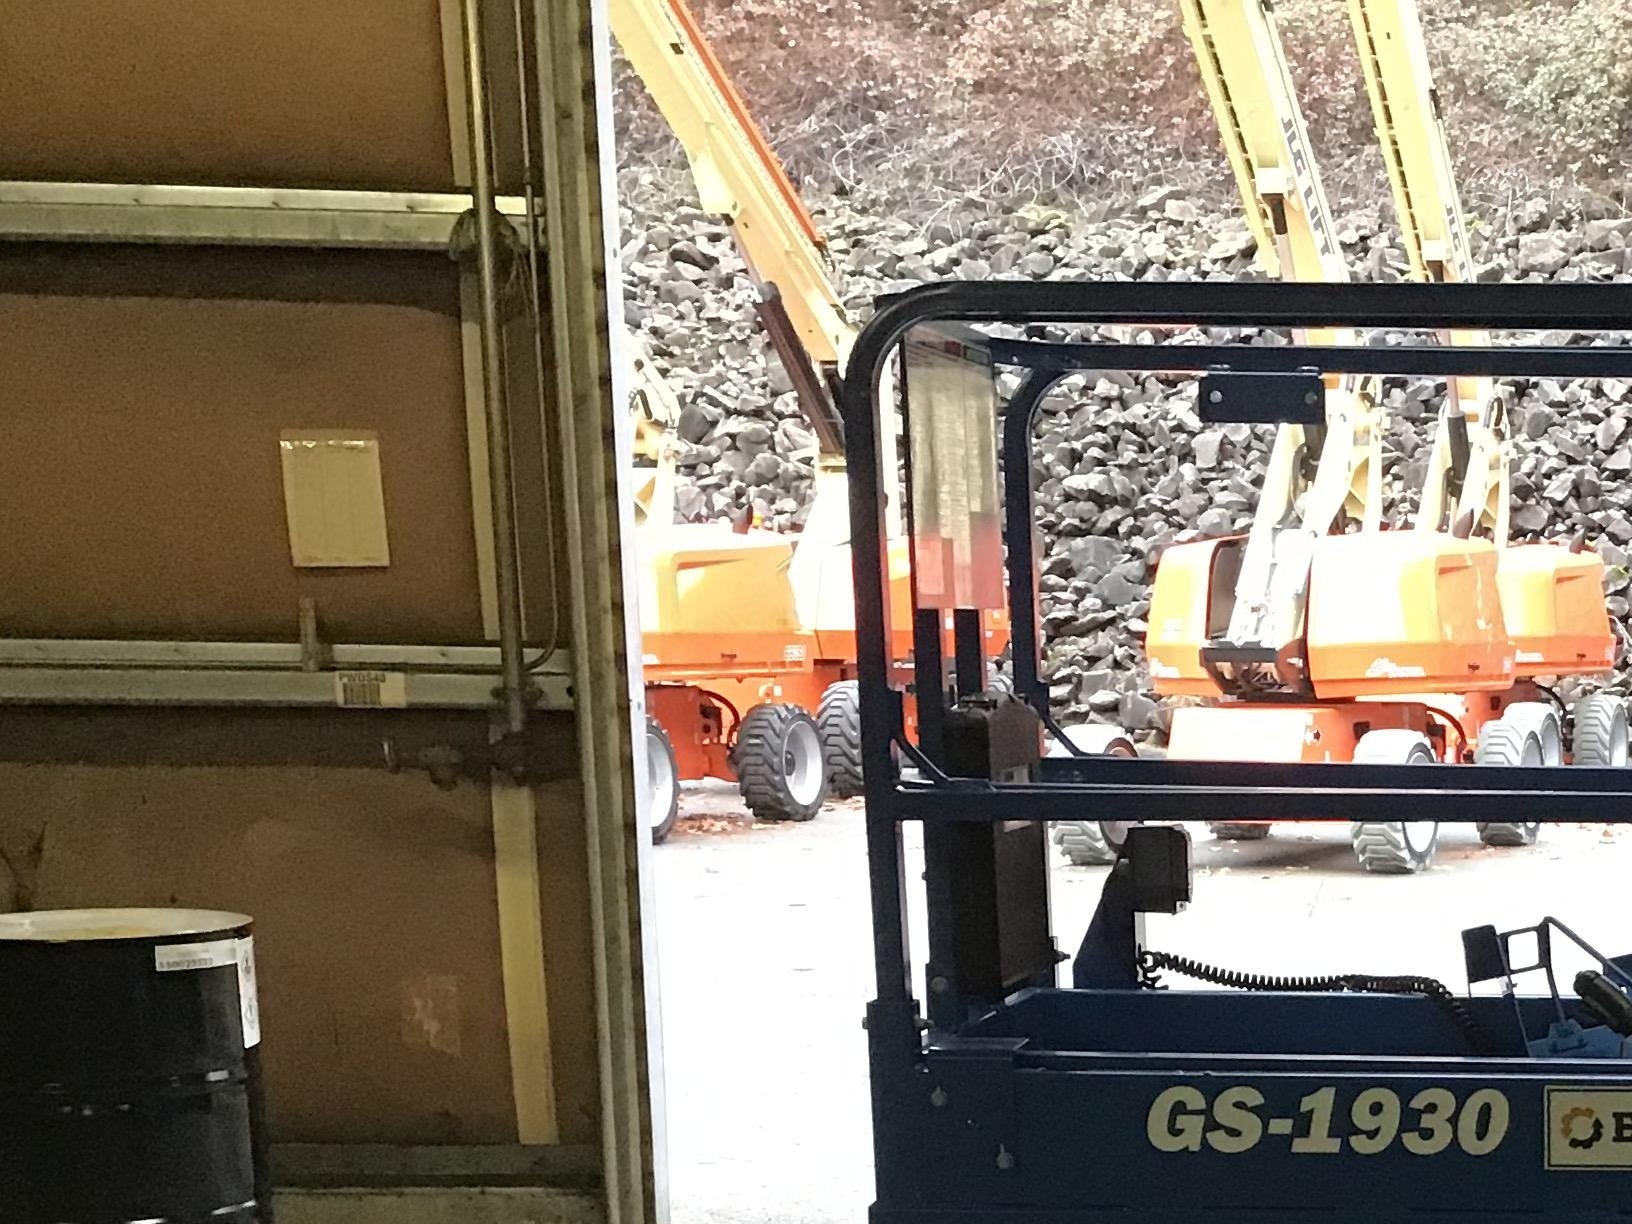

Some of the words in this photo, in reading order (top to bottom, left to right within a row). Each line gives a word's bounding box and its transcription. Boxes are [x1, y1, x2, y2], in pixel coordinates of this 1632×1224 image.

[1281, 117, 1306, 177] JLG
[1303, 185, 1331, 257] LIFT
[1146, 1085, 1510, 1156] GS-1930
